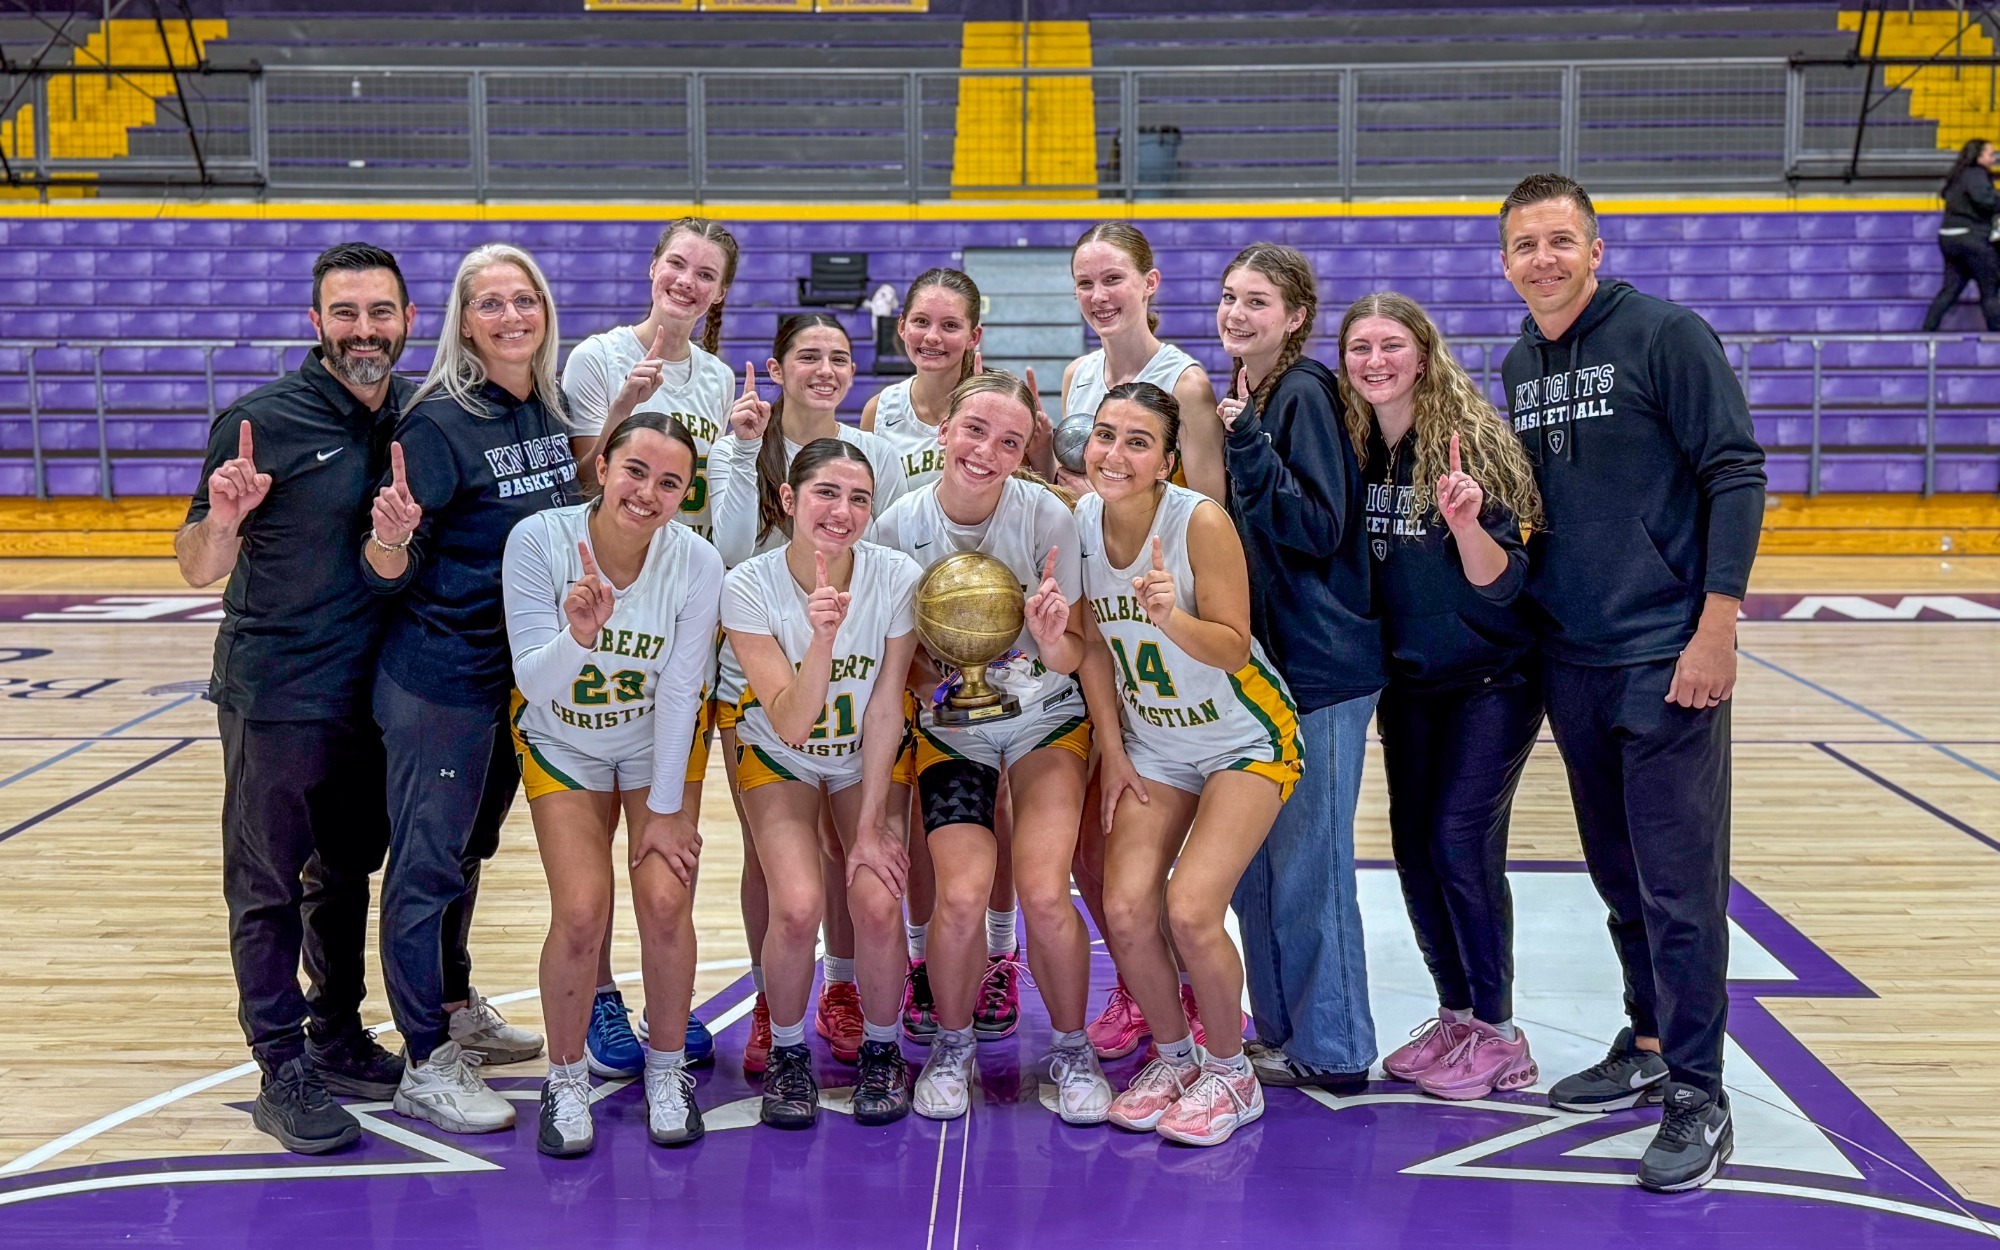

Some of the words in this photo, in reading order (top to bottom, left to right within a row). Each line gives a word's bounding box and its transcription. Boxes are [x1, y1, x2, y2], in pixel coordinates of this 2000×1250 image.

[483, 432, 574, 478] KNIGHT
[592, 626, 666, 660] BERT
[571, 663, 647, 706] 23
[1110, 635, 1178, 699] 14
